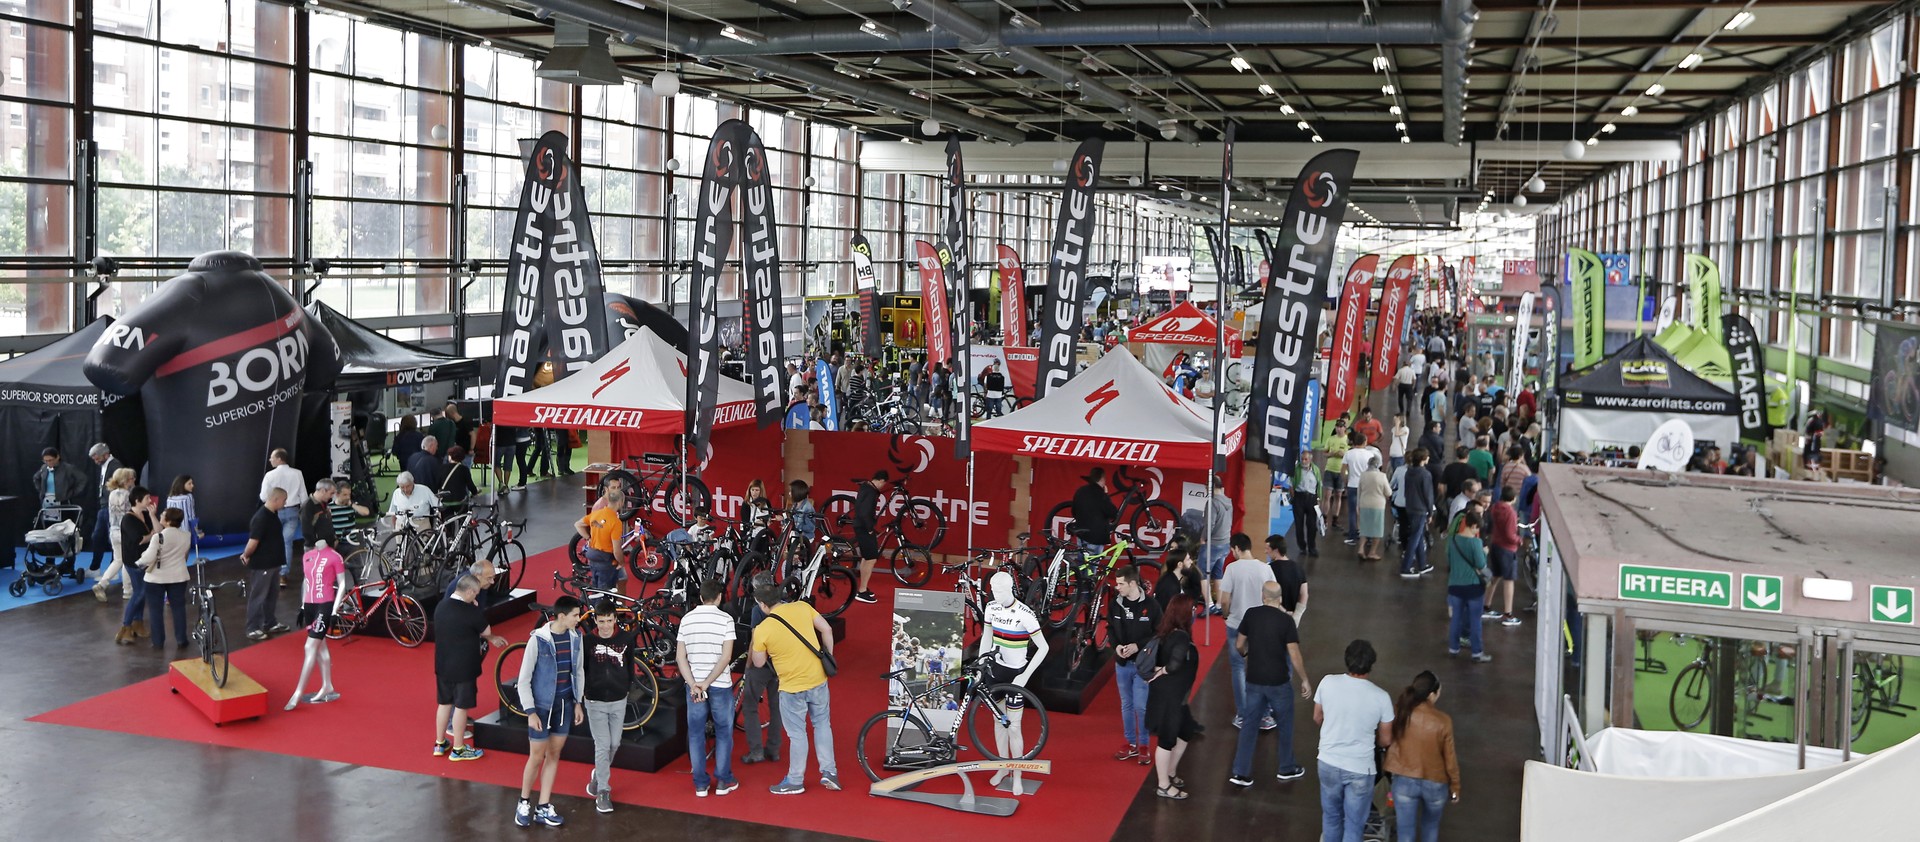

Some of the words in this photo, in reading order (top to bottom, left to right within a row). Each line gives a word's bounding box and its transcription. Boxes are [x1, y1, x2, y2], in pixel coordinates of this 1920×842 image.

[1264, 210, 1327, 457] maestre
[1336, 291, 1361, 402] SPEEDSIX
[1380, 283, 1401, 376] SPEEDSIX
[1, 390, 41, 402] SUPERIOR
[43, 392, 74, 404] SPORTS
[76, 393, 97, 405] CARE
[205, 400, 265, 428] SUPERIOR
[267, 383, 298, 408] SPORTS
[1302, 385, 1313, 444] GIANT
[1595, 395, 1726, 411] www.zeroflats.com
[316, 558, 328, 599] maestre
[1625, 573, 1725, 599] IRTEERA
[991, 613, 1013, 625] Tinkoff
[1006, 762, 1040, 770] SPECIALIZED
